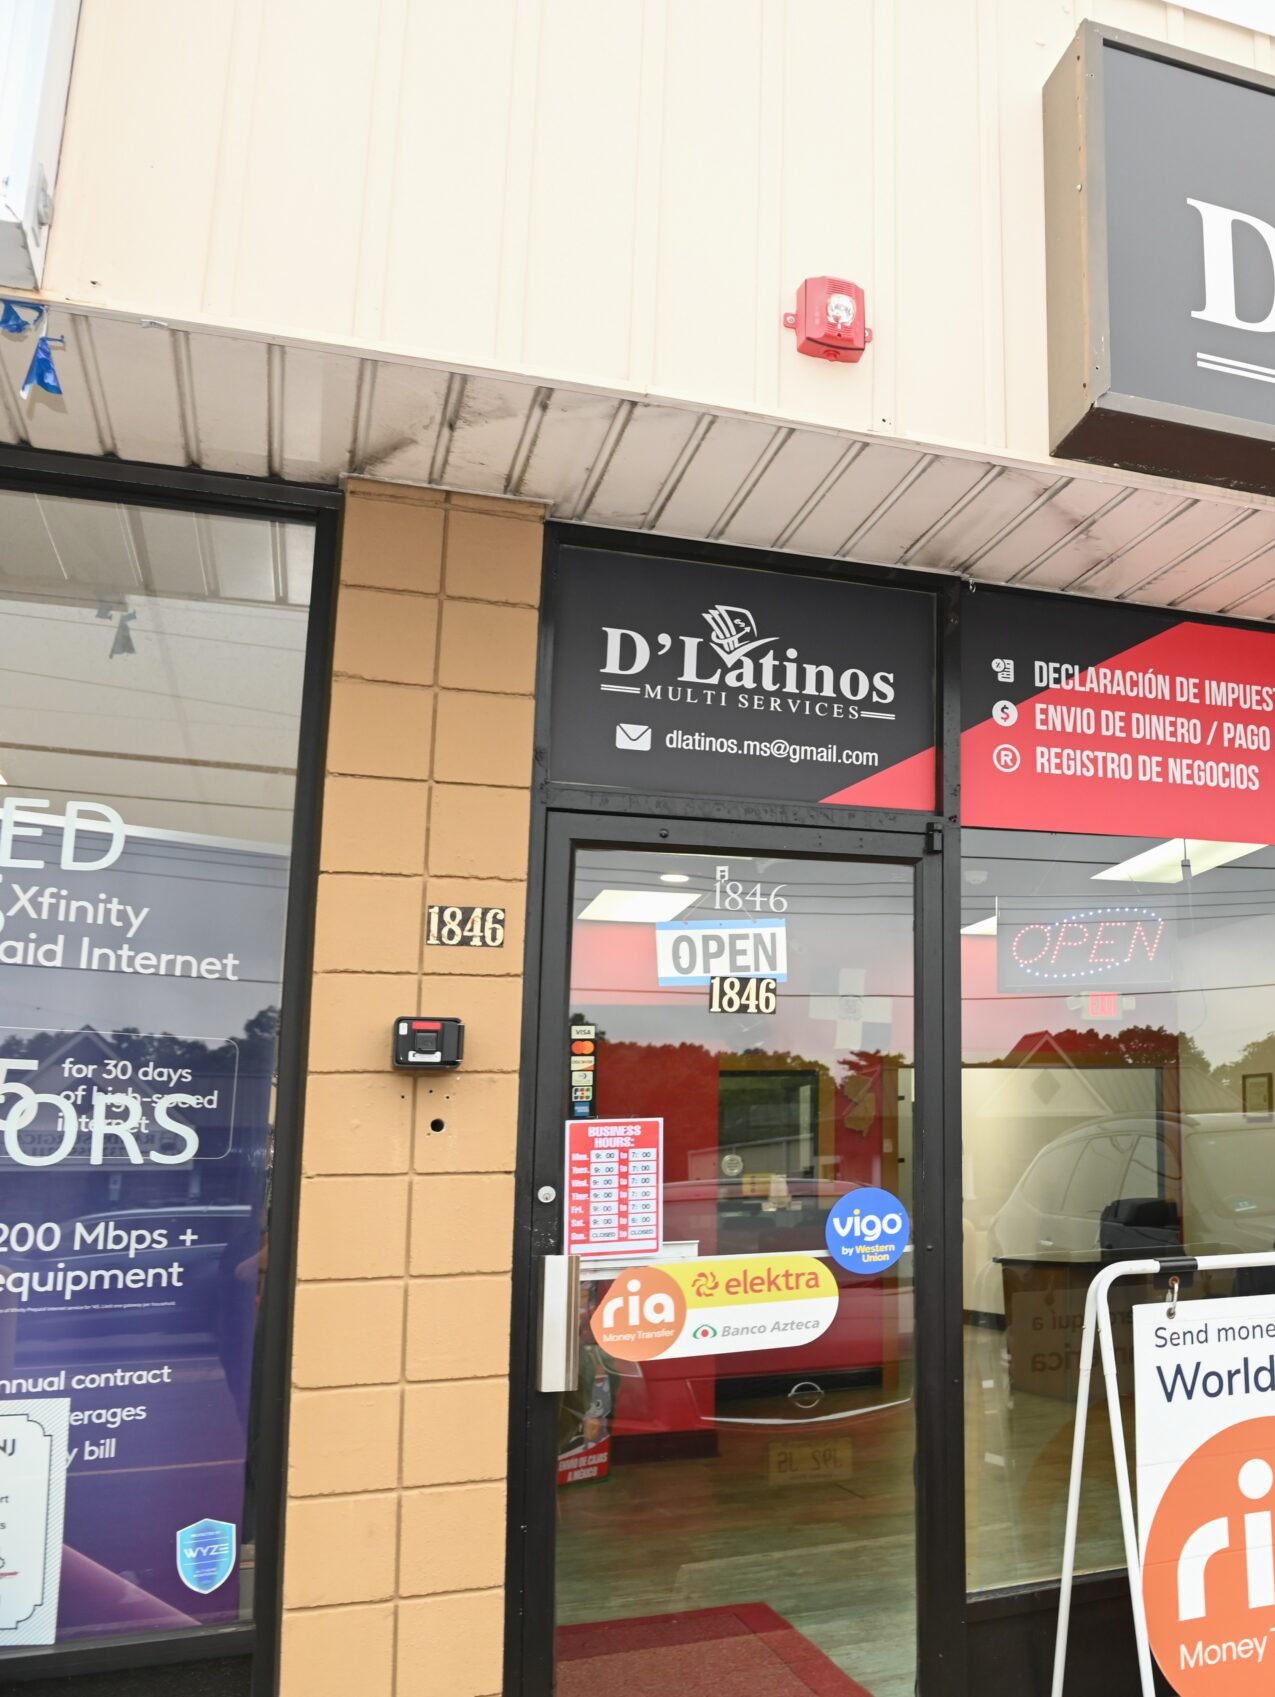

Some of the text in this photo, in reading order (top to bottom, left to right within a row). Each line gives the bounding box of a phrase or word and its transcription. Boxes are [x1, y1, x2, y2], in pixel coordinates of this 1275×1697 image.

[600, 627, 895, 703] D'Latinos
[1034, 661, 1170, 701] DECLARACIÓN
[1175, 677, 1200, 704] DE
[644, 684, 860, 720] MULTI SERVICES
[1035, 703, 1096, 735] ENVIO
[1101, 709, 1127, 738] DE
[1131, 712, 1202, 745] DINERO
[1206, 721, 1218, 746] /
[1223, 722, 1271, 752] PAGO
[665, 730, 878, 766] dlatinos.ms@gmail.com
[1036, 746, 1259, 791] REGISTRO DE NEGOCIOS
[7, 884, 150, 938] Xfinity
[714, 881, 788, 912] 1846
[427, 906, 504, 946] 1846
[1012, 921, 1166, 964] OPEN
[80, 938, 240, 981] Internet
[672, 932, 779, 977] OPEN
[710, 977, 776, 1013] 1846
[62, 1058, 98, 1078] for
[102, 1060, 132, 1080] 30
[138, 1062, 192, 1087] days
[588, 1125, 641, 1137] BUSINESS
[594, 1137, 635, 1149] HOURS:
[73, 1223, 168, 1257] Mbps
[832, 1208, 902, 1241] vigo
[841, 1243, 895, 1256] by Western
[862, 1252, 890, 1263] Union
[725, 1268, 820, 1297] elektra
[602, 1279, 675, 1329] ria
[602, 1327, 675, 1343] Money Transfer
[721, 1318, 820, 1338] Banco Azteca
[1154, 1324, 1209, 1348] Send
[71, 1365, 172, 1390] contract
[84, 1438, 116, 1461] bill
[184, 1543, 230, 1559] WYZE
[1179, 1634, 1268, 1670] Money
